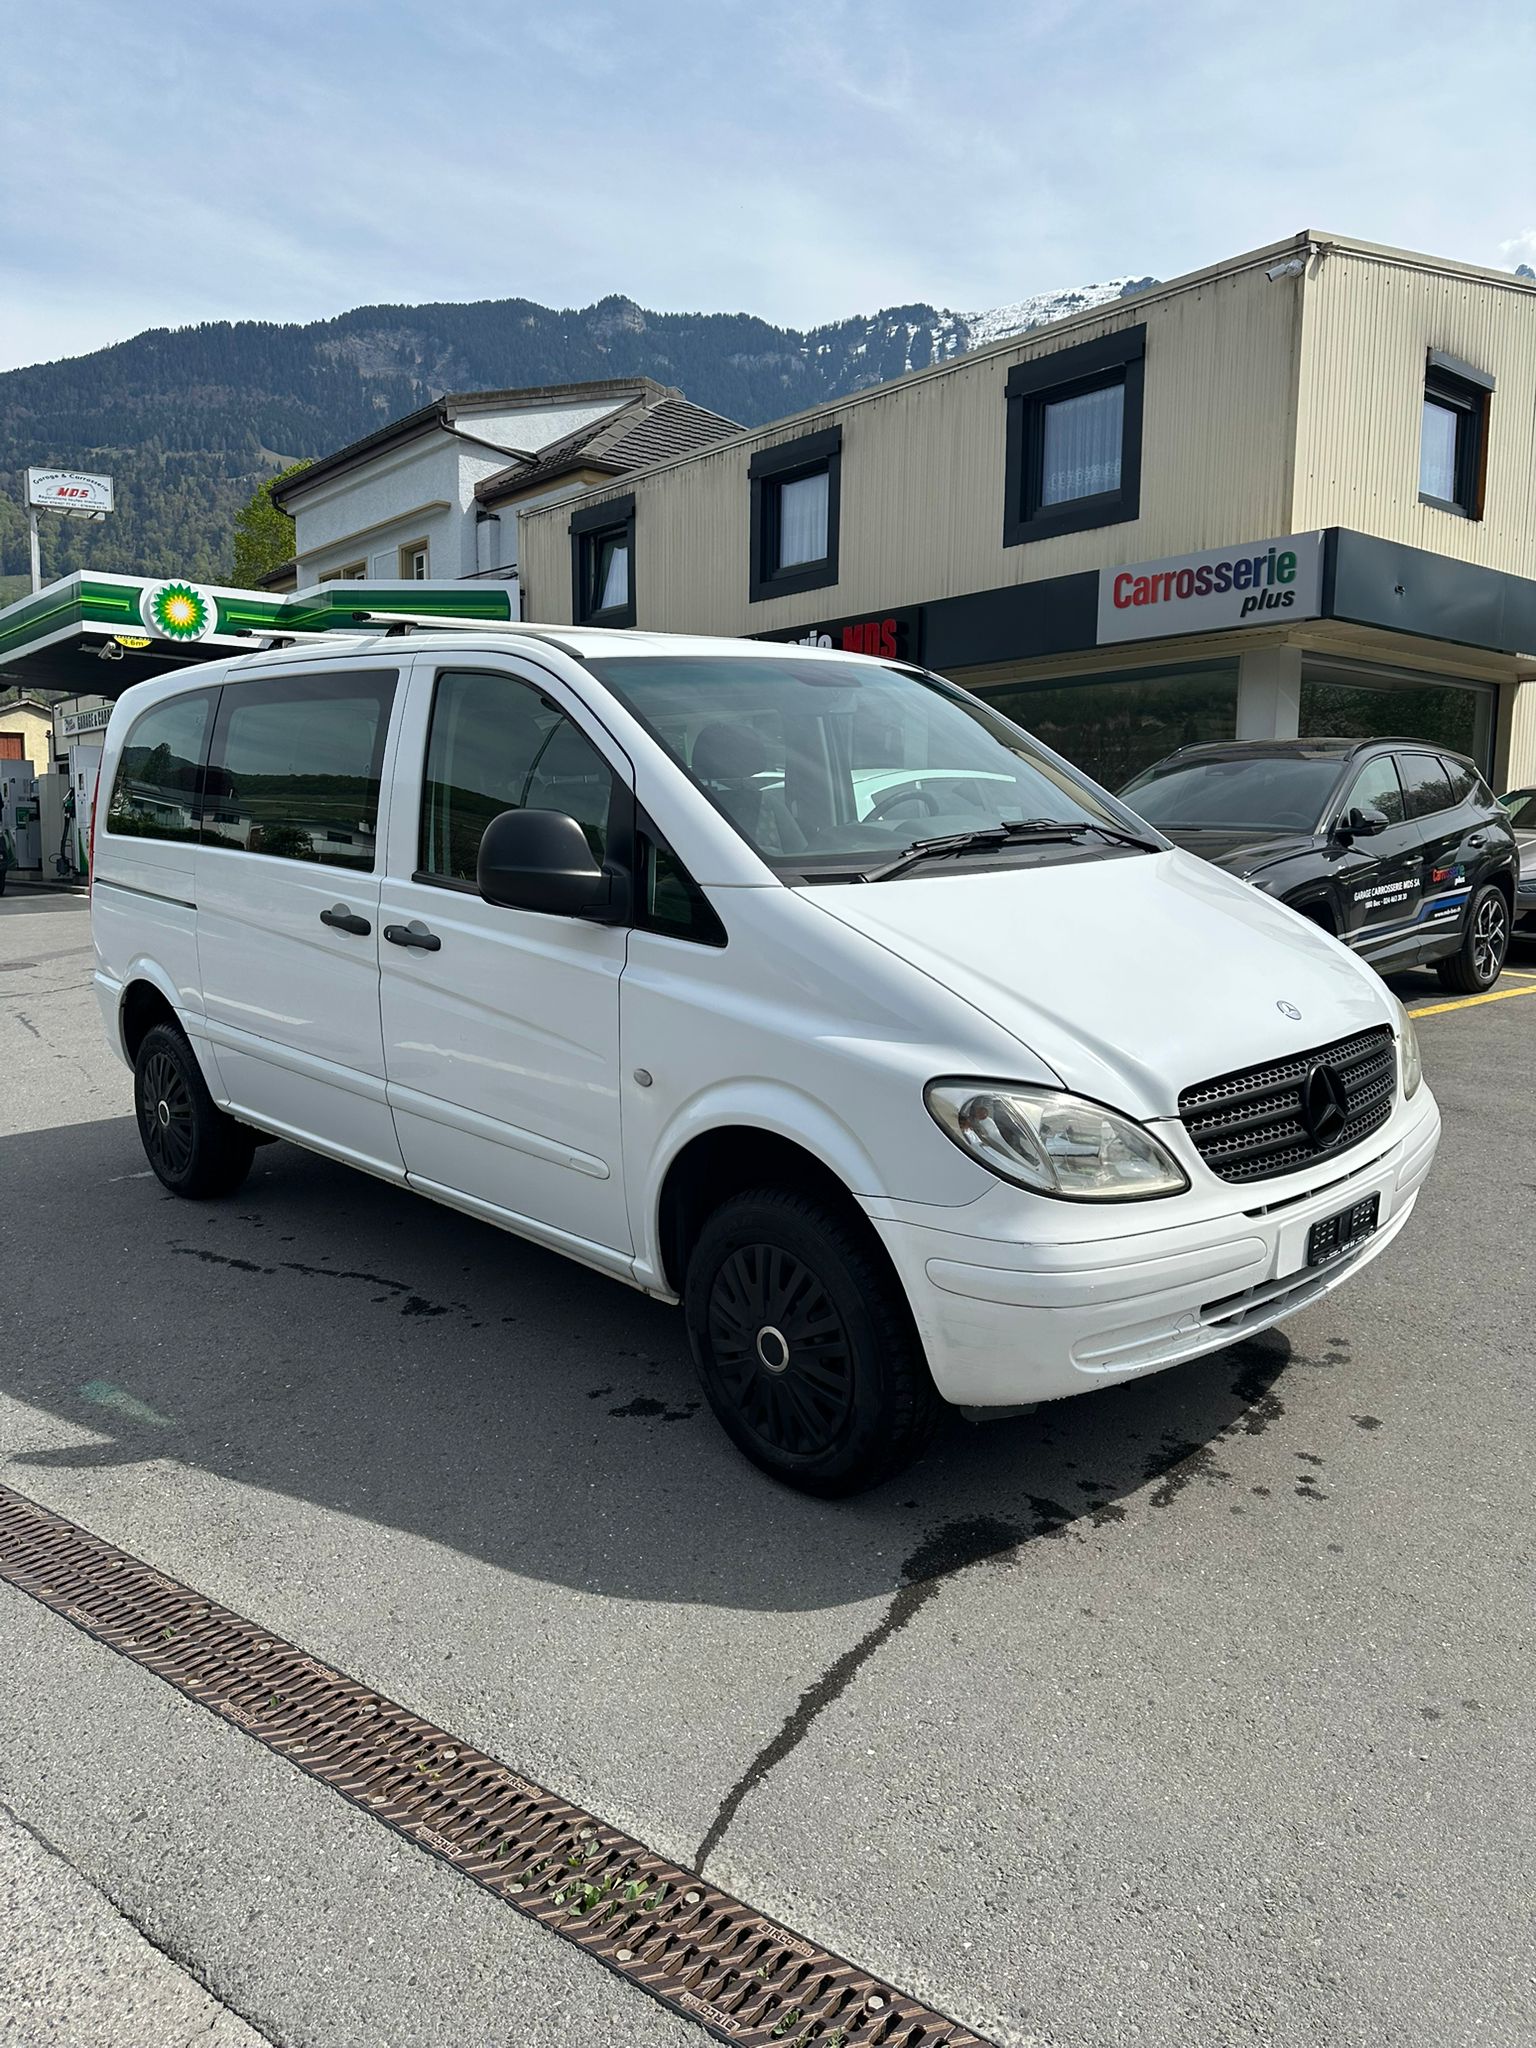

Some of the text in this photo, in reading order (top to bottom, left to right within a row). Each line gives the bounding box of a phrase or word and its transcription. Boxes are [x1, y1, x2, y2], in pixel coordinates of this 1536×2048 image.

[33, 473, 59, 485] Garage
[69, 473, 109, 492] Carrosserie
[57, 487, 89, 498] MDS
[1113, 547, 1297, 609] Carrosserie
[1239, 588, 1296, 618] plus
[843, 618, 897, 659] MDS
[77, 712, 94, 730] GARAGE
[1432, 863, 1465, 882] Carrosserie
[1353, 878, 1420, 901] GARAGE CARROSSERIE MDS SA
[500, 1773, 528, 1790] BIRCO
[431, 1835, 458, 1855] BIRCO
[761, 1924, 795, 1946] BIRCO
[700, 2004, 736, 2030] BIRCO
